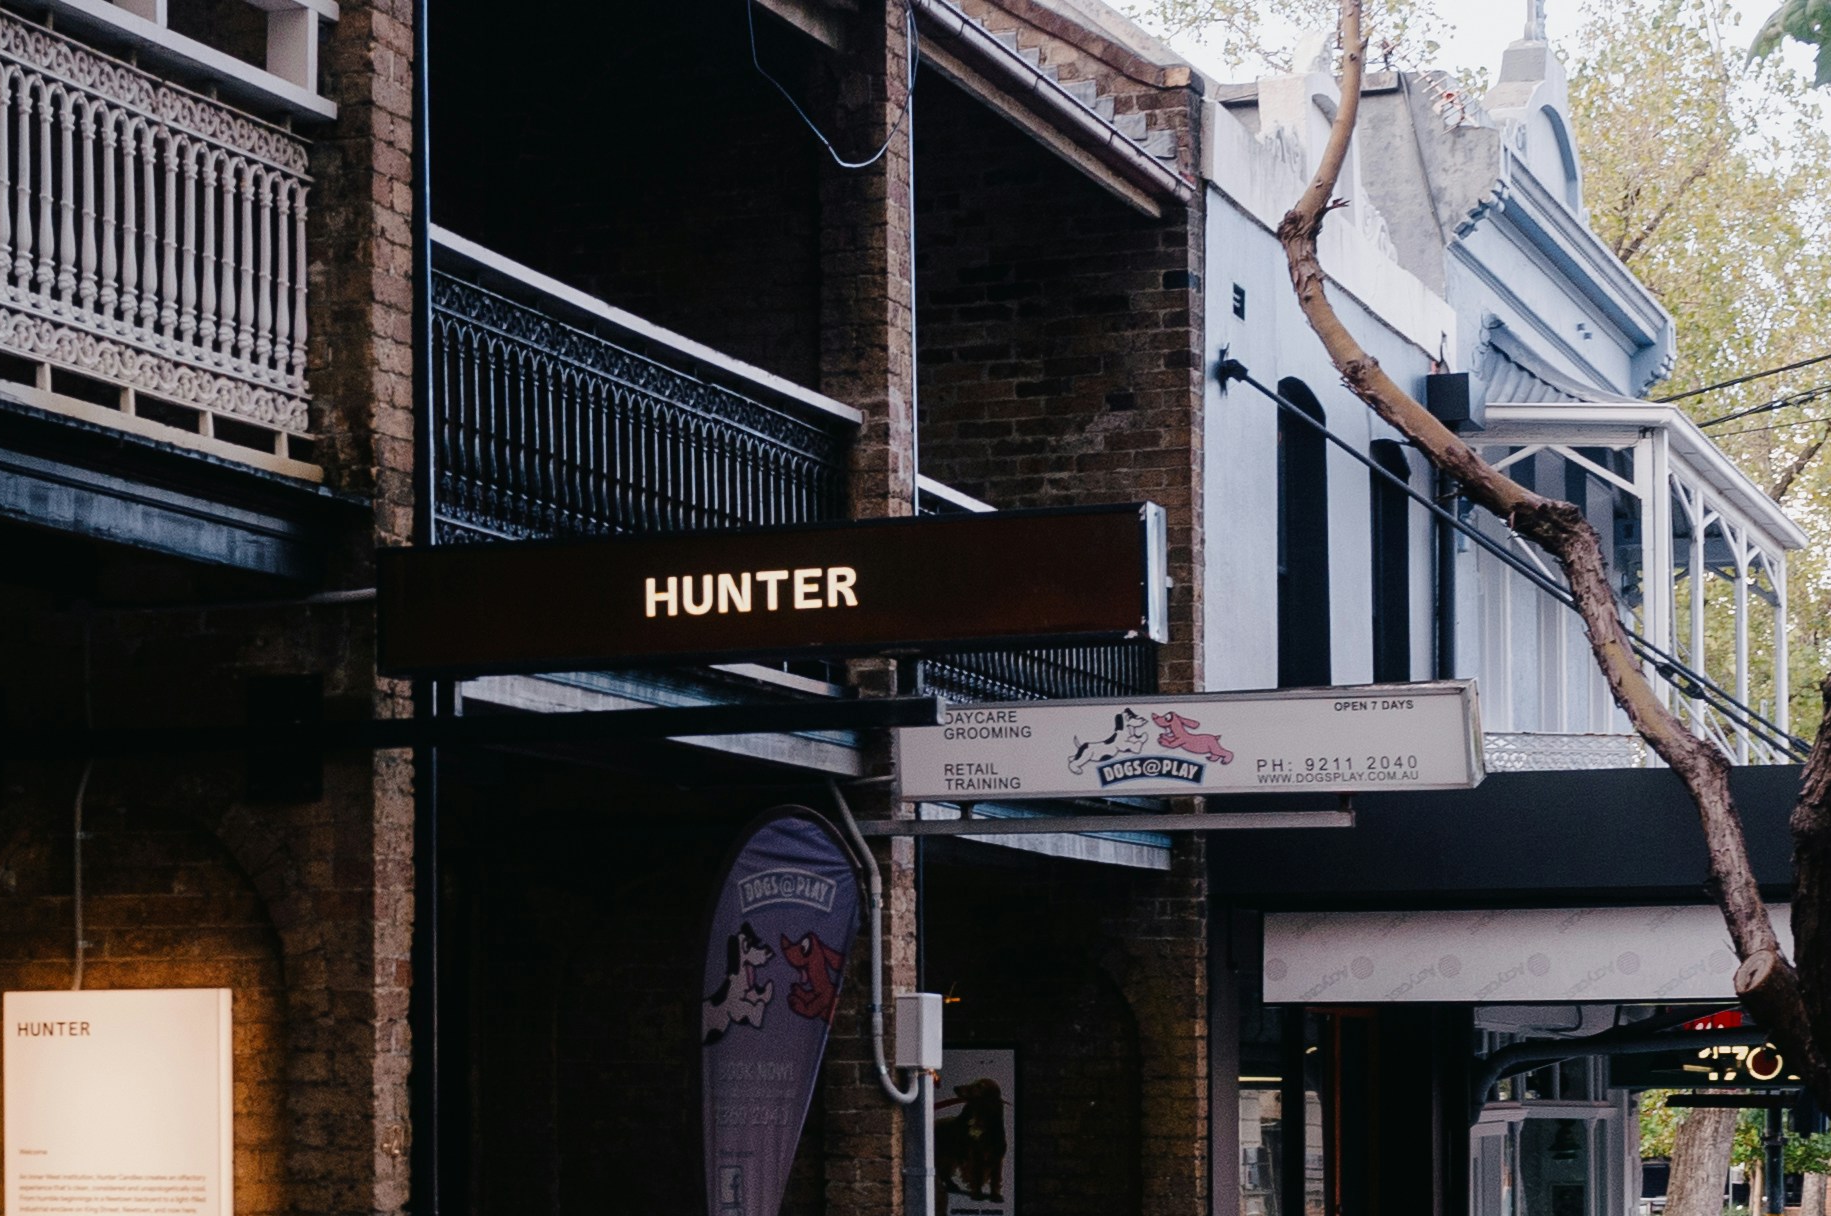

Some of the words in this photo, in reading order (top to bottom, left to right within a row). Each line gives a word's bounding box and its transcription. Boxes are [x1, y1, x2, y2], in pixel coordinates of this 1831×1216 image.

[644, 565, 859, 619] HUNTER
[1334, 701, 1367, 711] OPEN
[1370, 701, 1377, 710] 7
[1381, 700, 1414, 710] DAYS
[945, 710, 1017, 725] DAYCARE
[944, 726, 1032, 740] GROOMING
[944, 763, 998, 776] RETAIL
[1102, 759, 1199, 782] DOGS@PLAY
[1256, 759, 1293, 772] PH:
[1304, 757, 1352, 771] 9211
[1366, 755, 1418, 769] 2040
[945, 777, 1021, 790] TRAINING
[1257, 770, 1419, 783] WWW.DOGSPLAY.COM.AU
[744, 874, 829, 903] DOGS@PLAY
[16, 1021, 91, 1037] HUNTER
